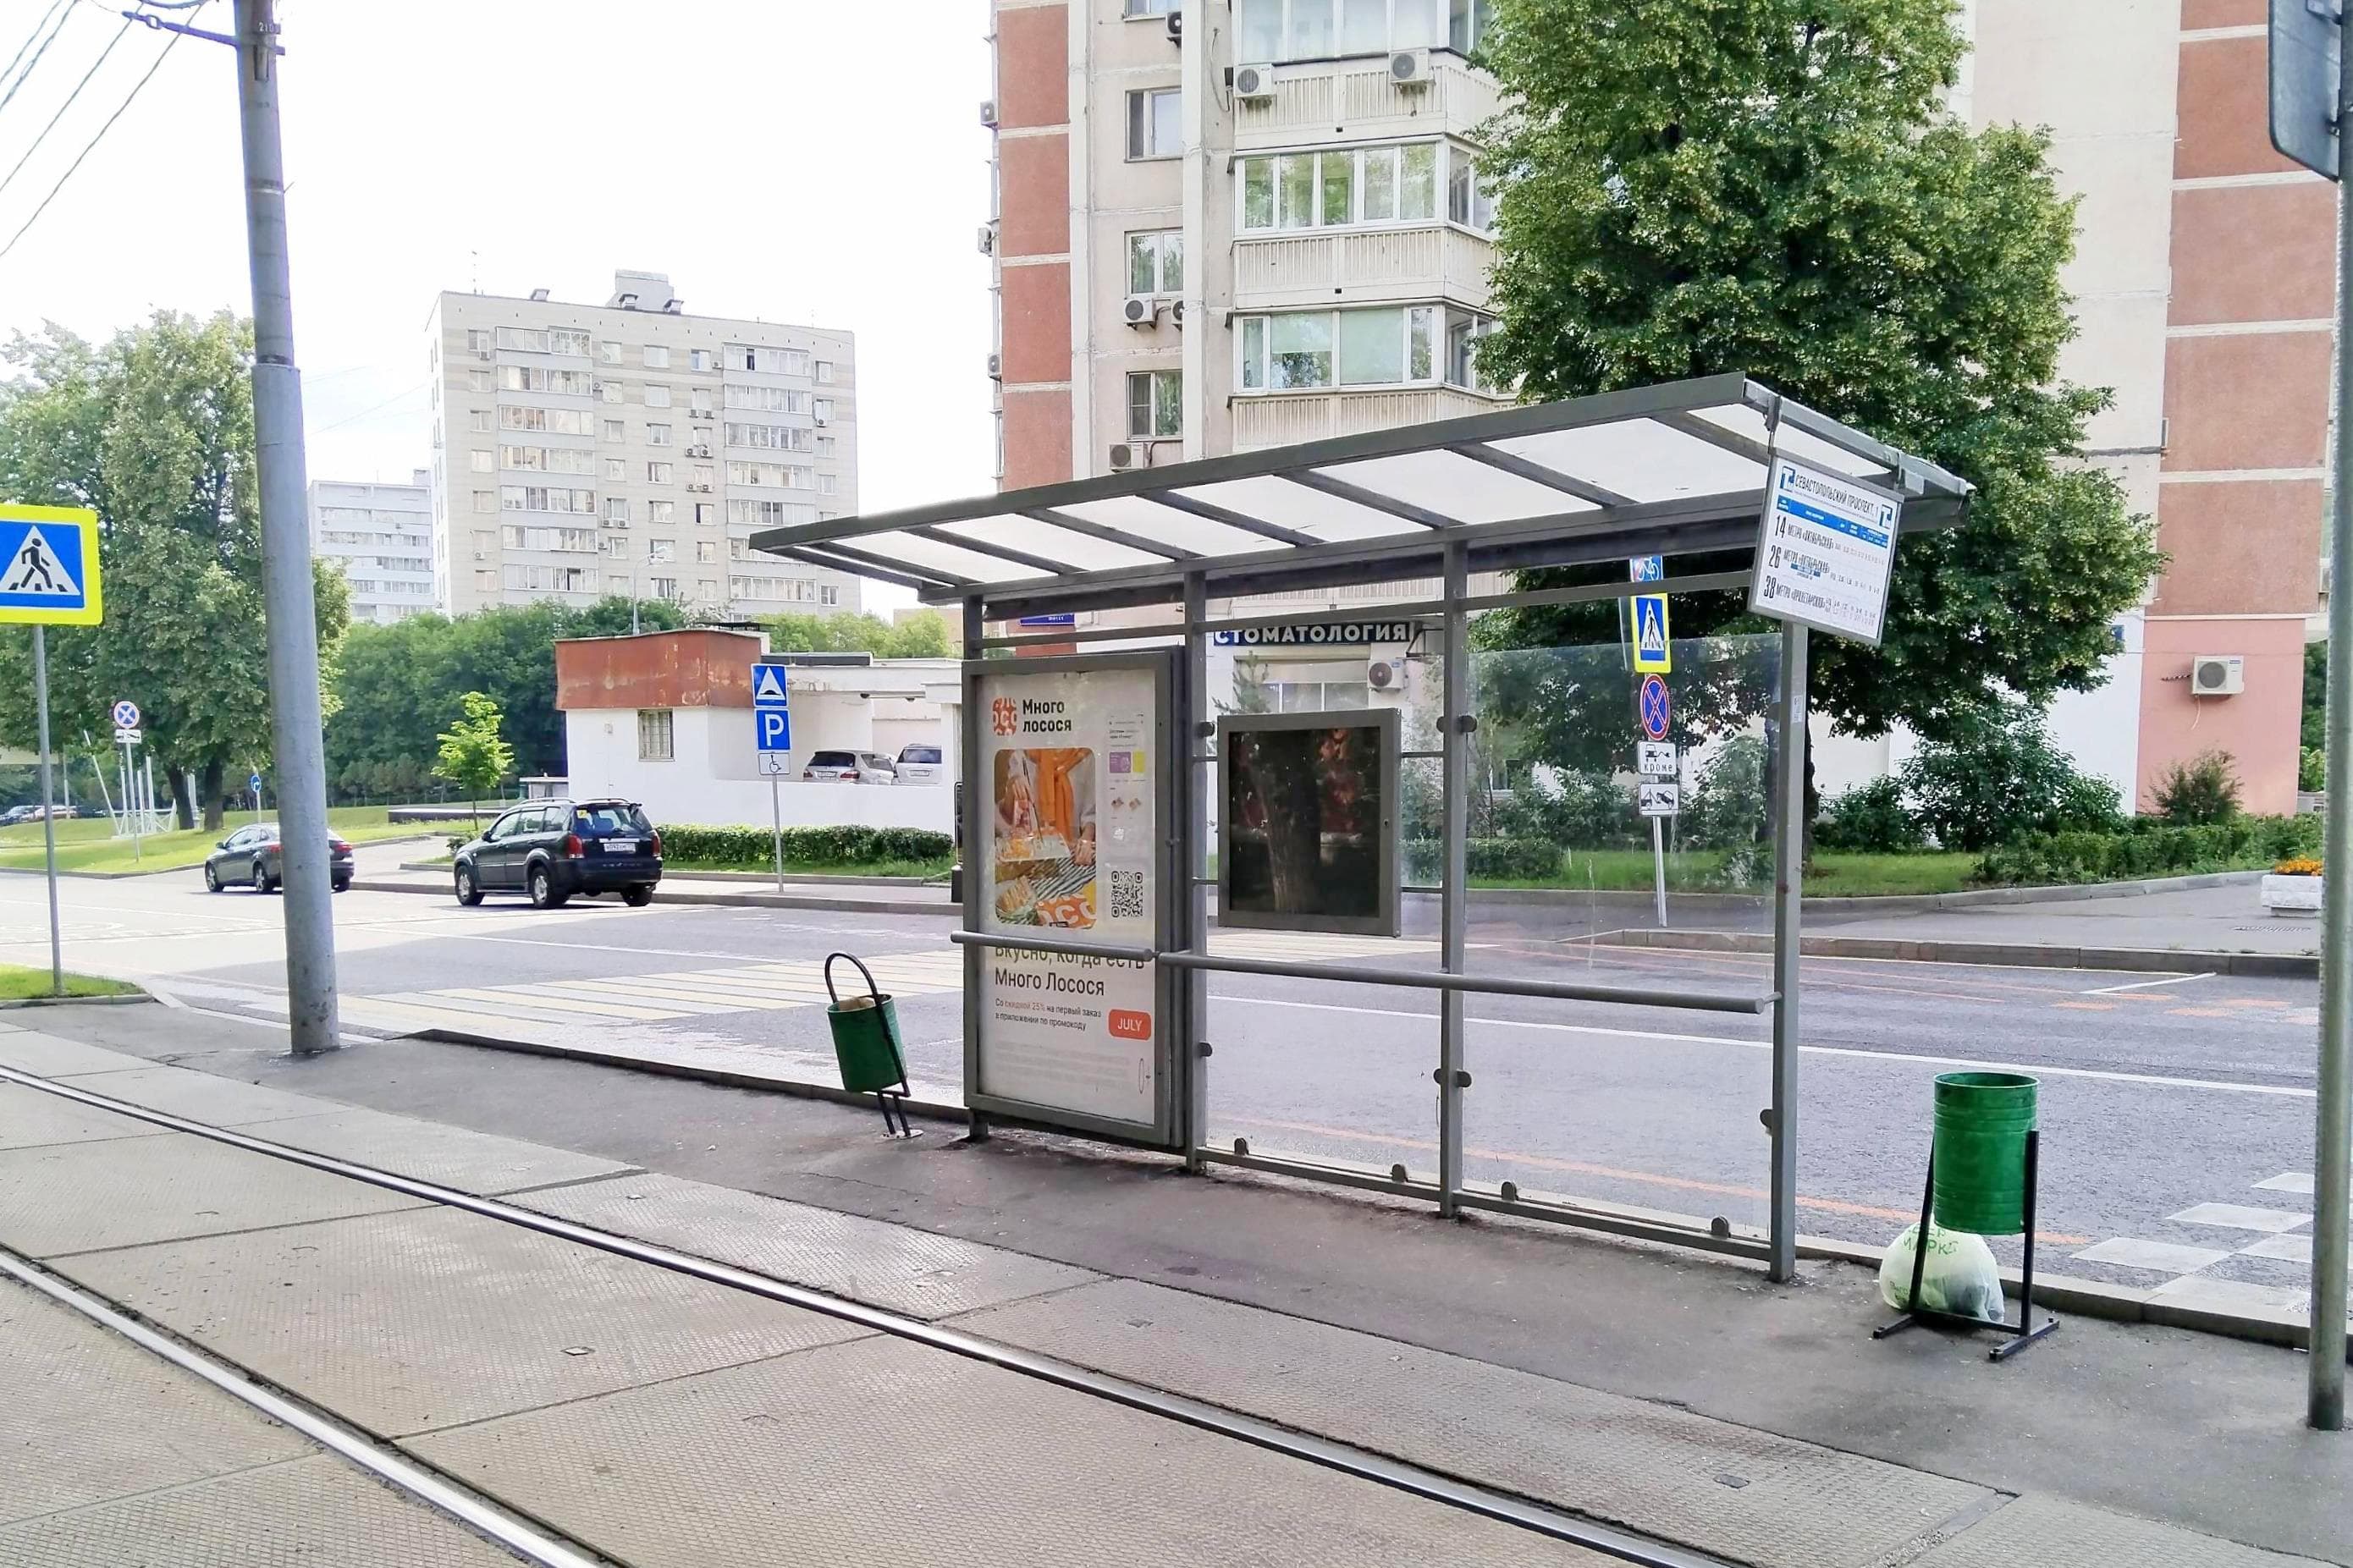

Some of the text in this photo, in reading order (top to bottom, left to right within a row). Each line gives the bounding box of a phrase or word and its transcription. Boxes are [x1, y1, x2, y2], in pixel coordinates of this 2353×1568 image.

[1795, 474, 1848, 503] СЕВАСТОПОЛЬСКИЙ
[1775, 514, 1787, 538] 14
[1768, 545, 1782, 569] 26
[1763, 575, 1777, 599] 38
[1215, 624, 1407, 644] СТОМАТОЛОГИЯ
[1022, 698, 1065, 715] Много
[764, 713, 784, 746] P
[1022, 719, 1072, 733] лосося
[1644, 763, 1672, 773] кроме
[995, 967, 1105, 996] Много Лосося
[995, 998, 1004, 1007] Со
[1055, 1006, 1082, 1015] первый
[1082, 1009, 1101, 1018] заказ
[1049, 1019, 1086, 1032] промокоду
[1117, 1018, 1143, 1032] JULY
